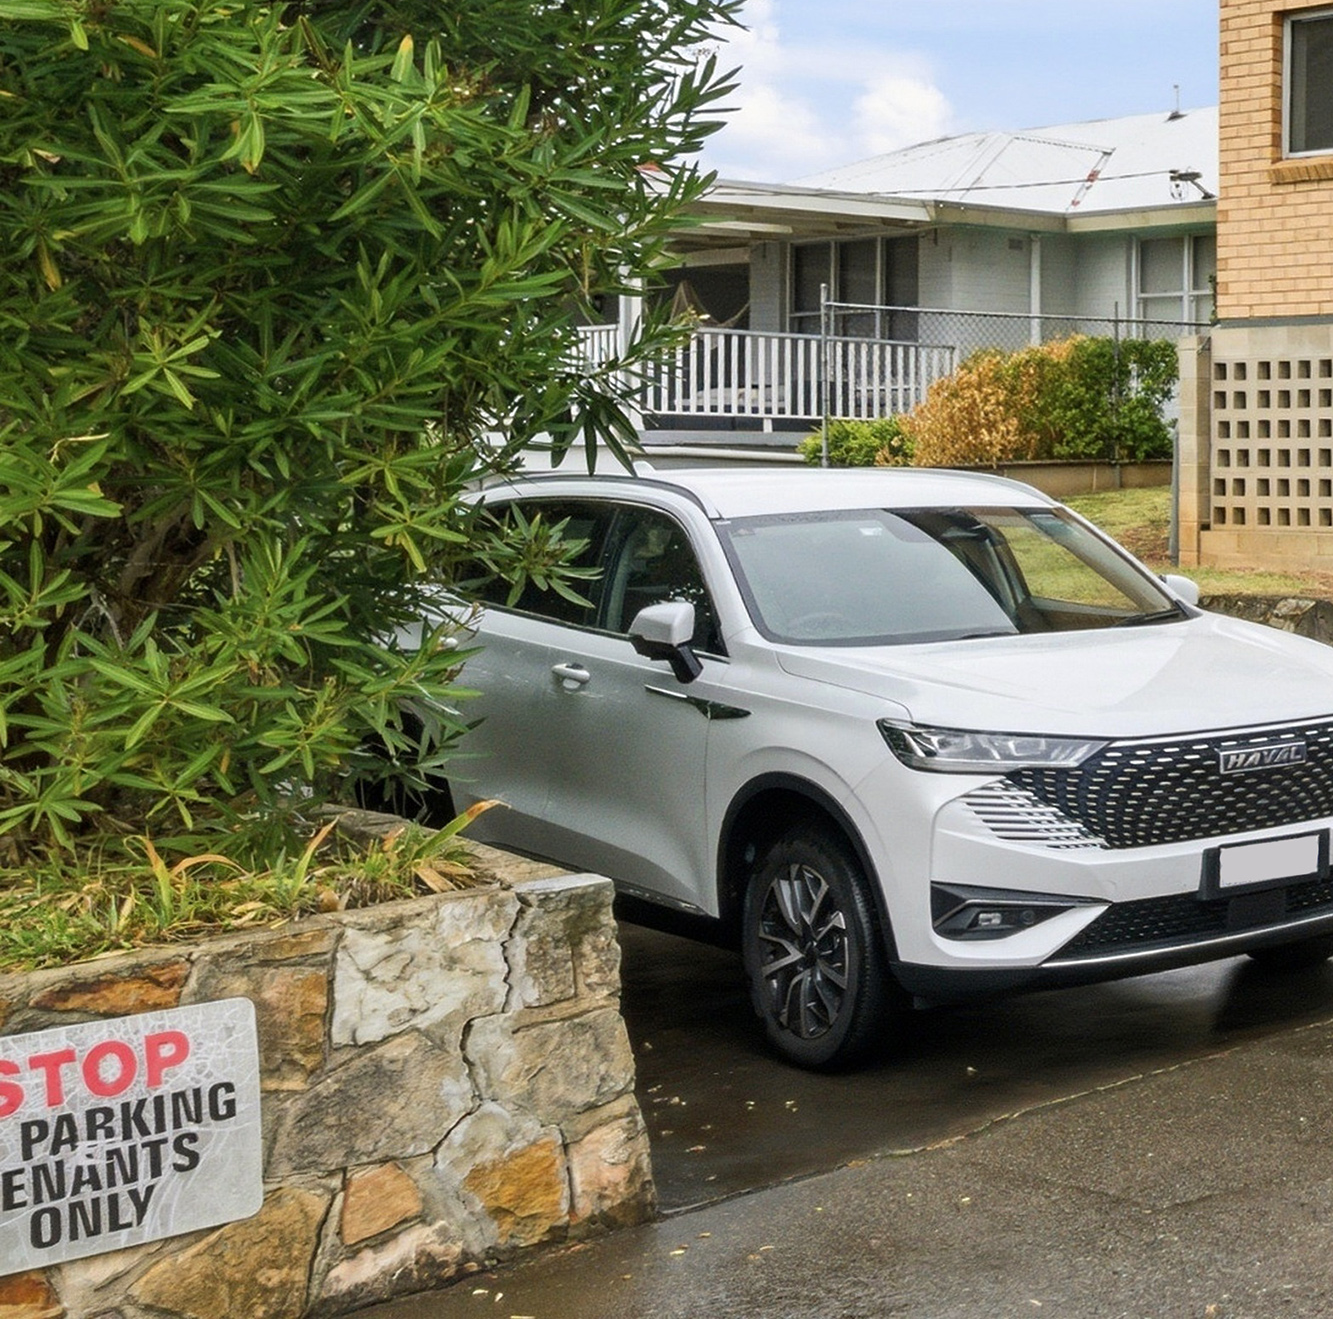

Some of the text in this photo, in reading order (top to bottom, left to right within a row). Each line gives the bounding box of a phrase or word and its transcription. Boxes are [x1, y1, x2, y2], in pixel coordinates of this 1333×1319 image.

[1227, 747, 1302, 770] HAVAL
[20, 1081, 237, 1162] PARKING
[1, 1132, 200, 1212] ENANTS
[30, 1184, 155, 1249] ONLY
